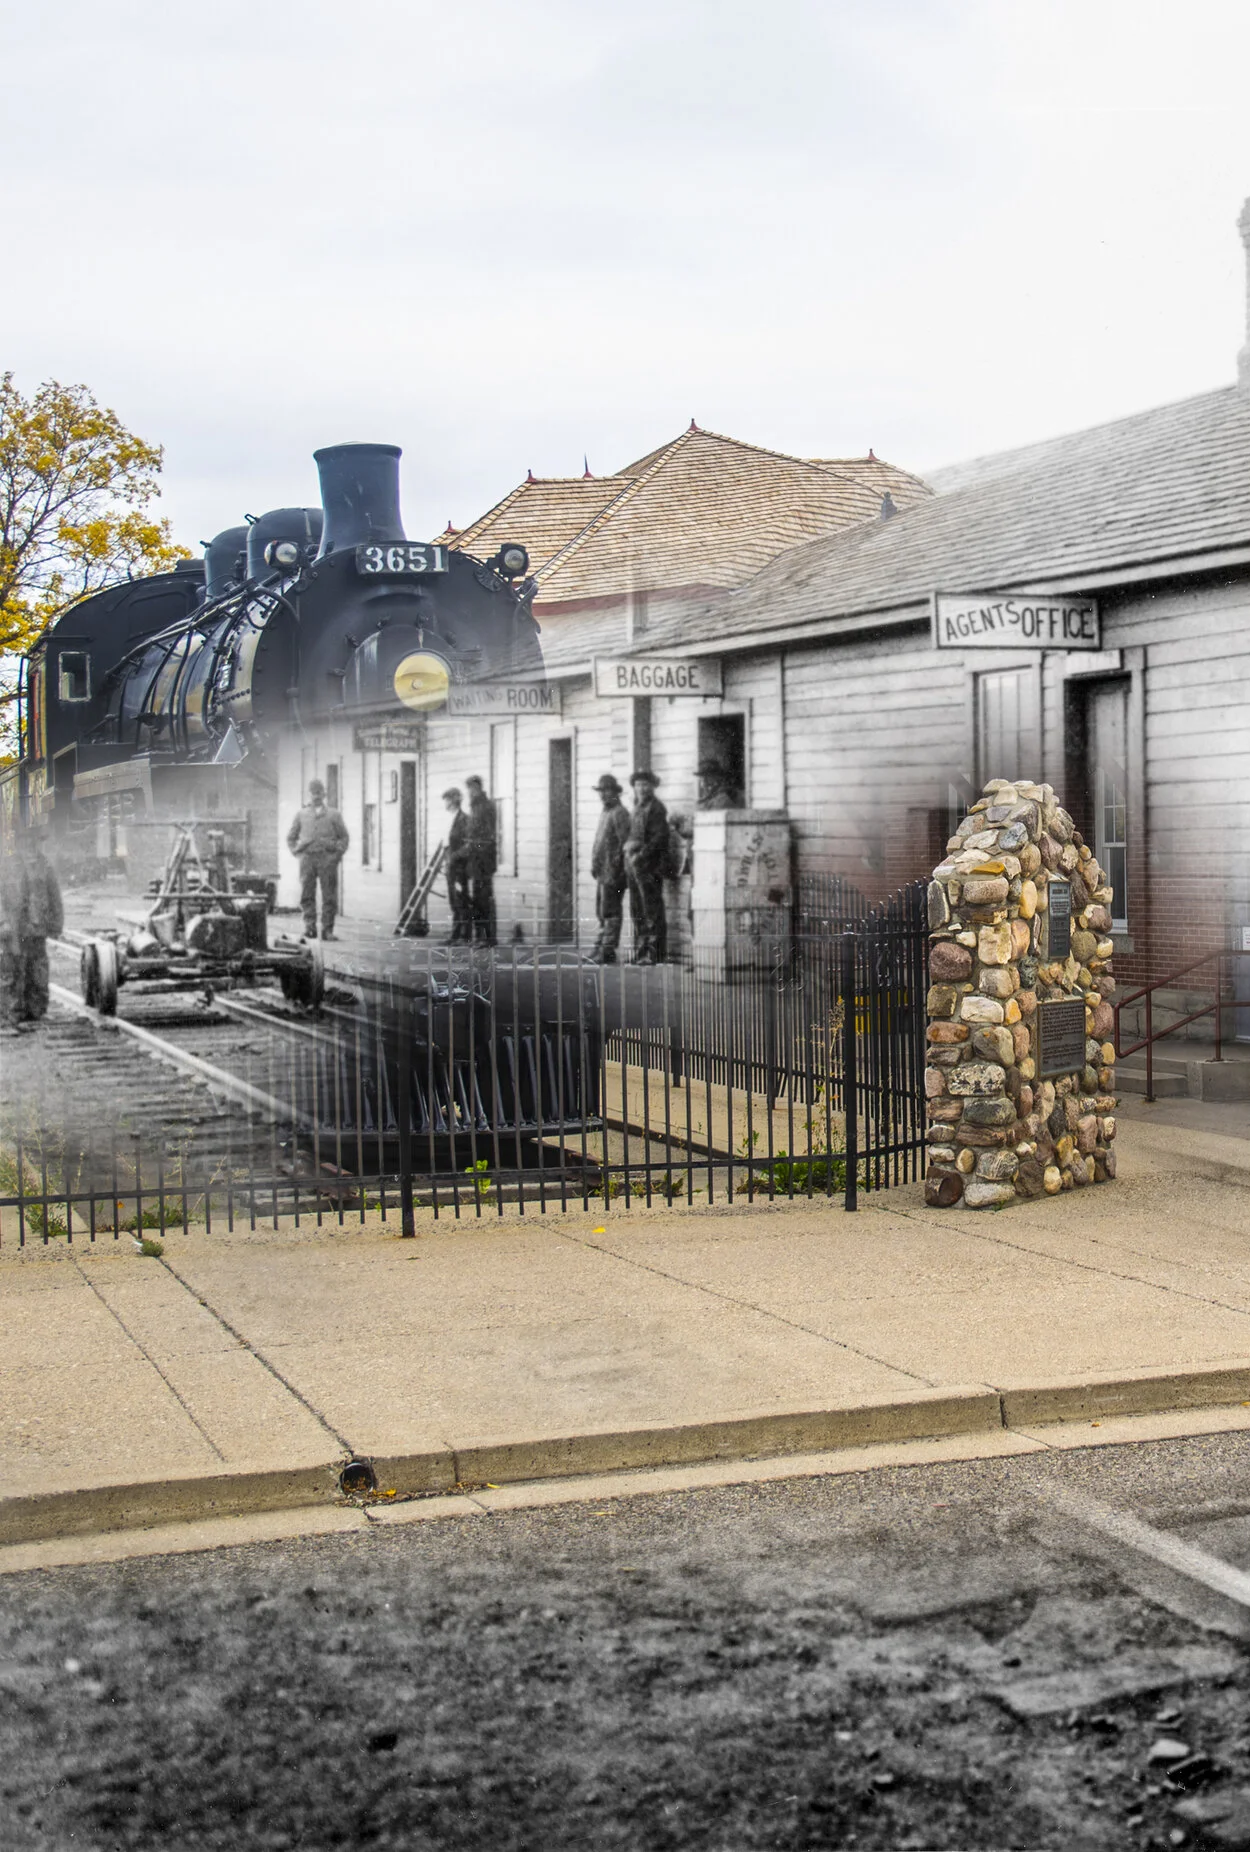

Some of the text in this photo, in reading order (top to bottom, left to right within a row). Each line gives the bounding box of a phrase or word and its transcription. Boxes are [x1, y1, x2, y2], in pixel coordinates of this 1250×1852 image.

[365, 547, 444, 572] 3651
[945, 600, 1095, 641] AGENTS OFFICE
[616, 665, 700, 688] BAGGAGE
[507, 688, 554, 709] ROOM
